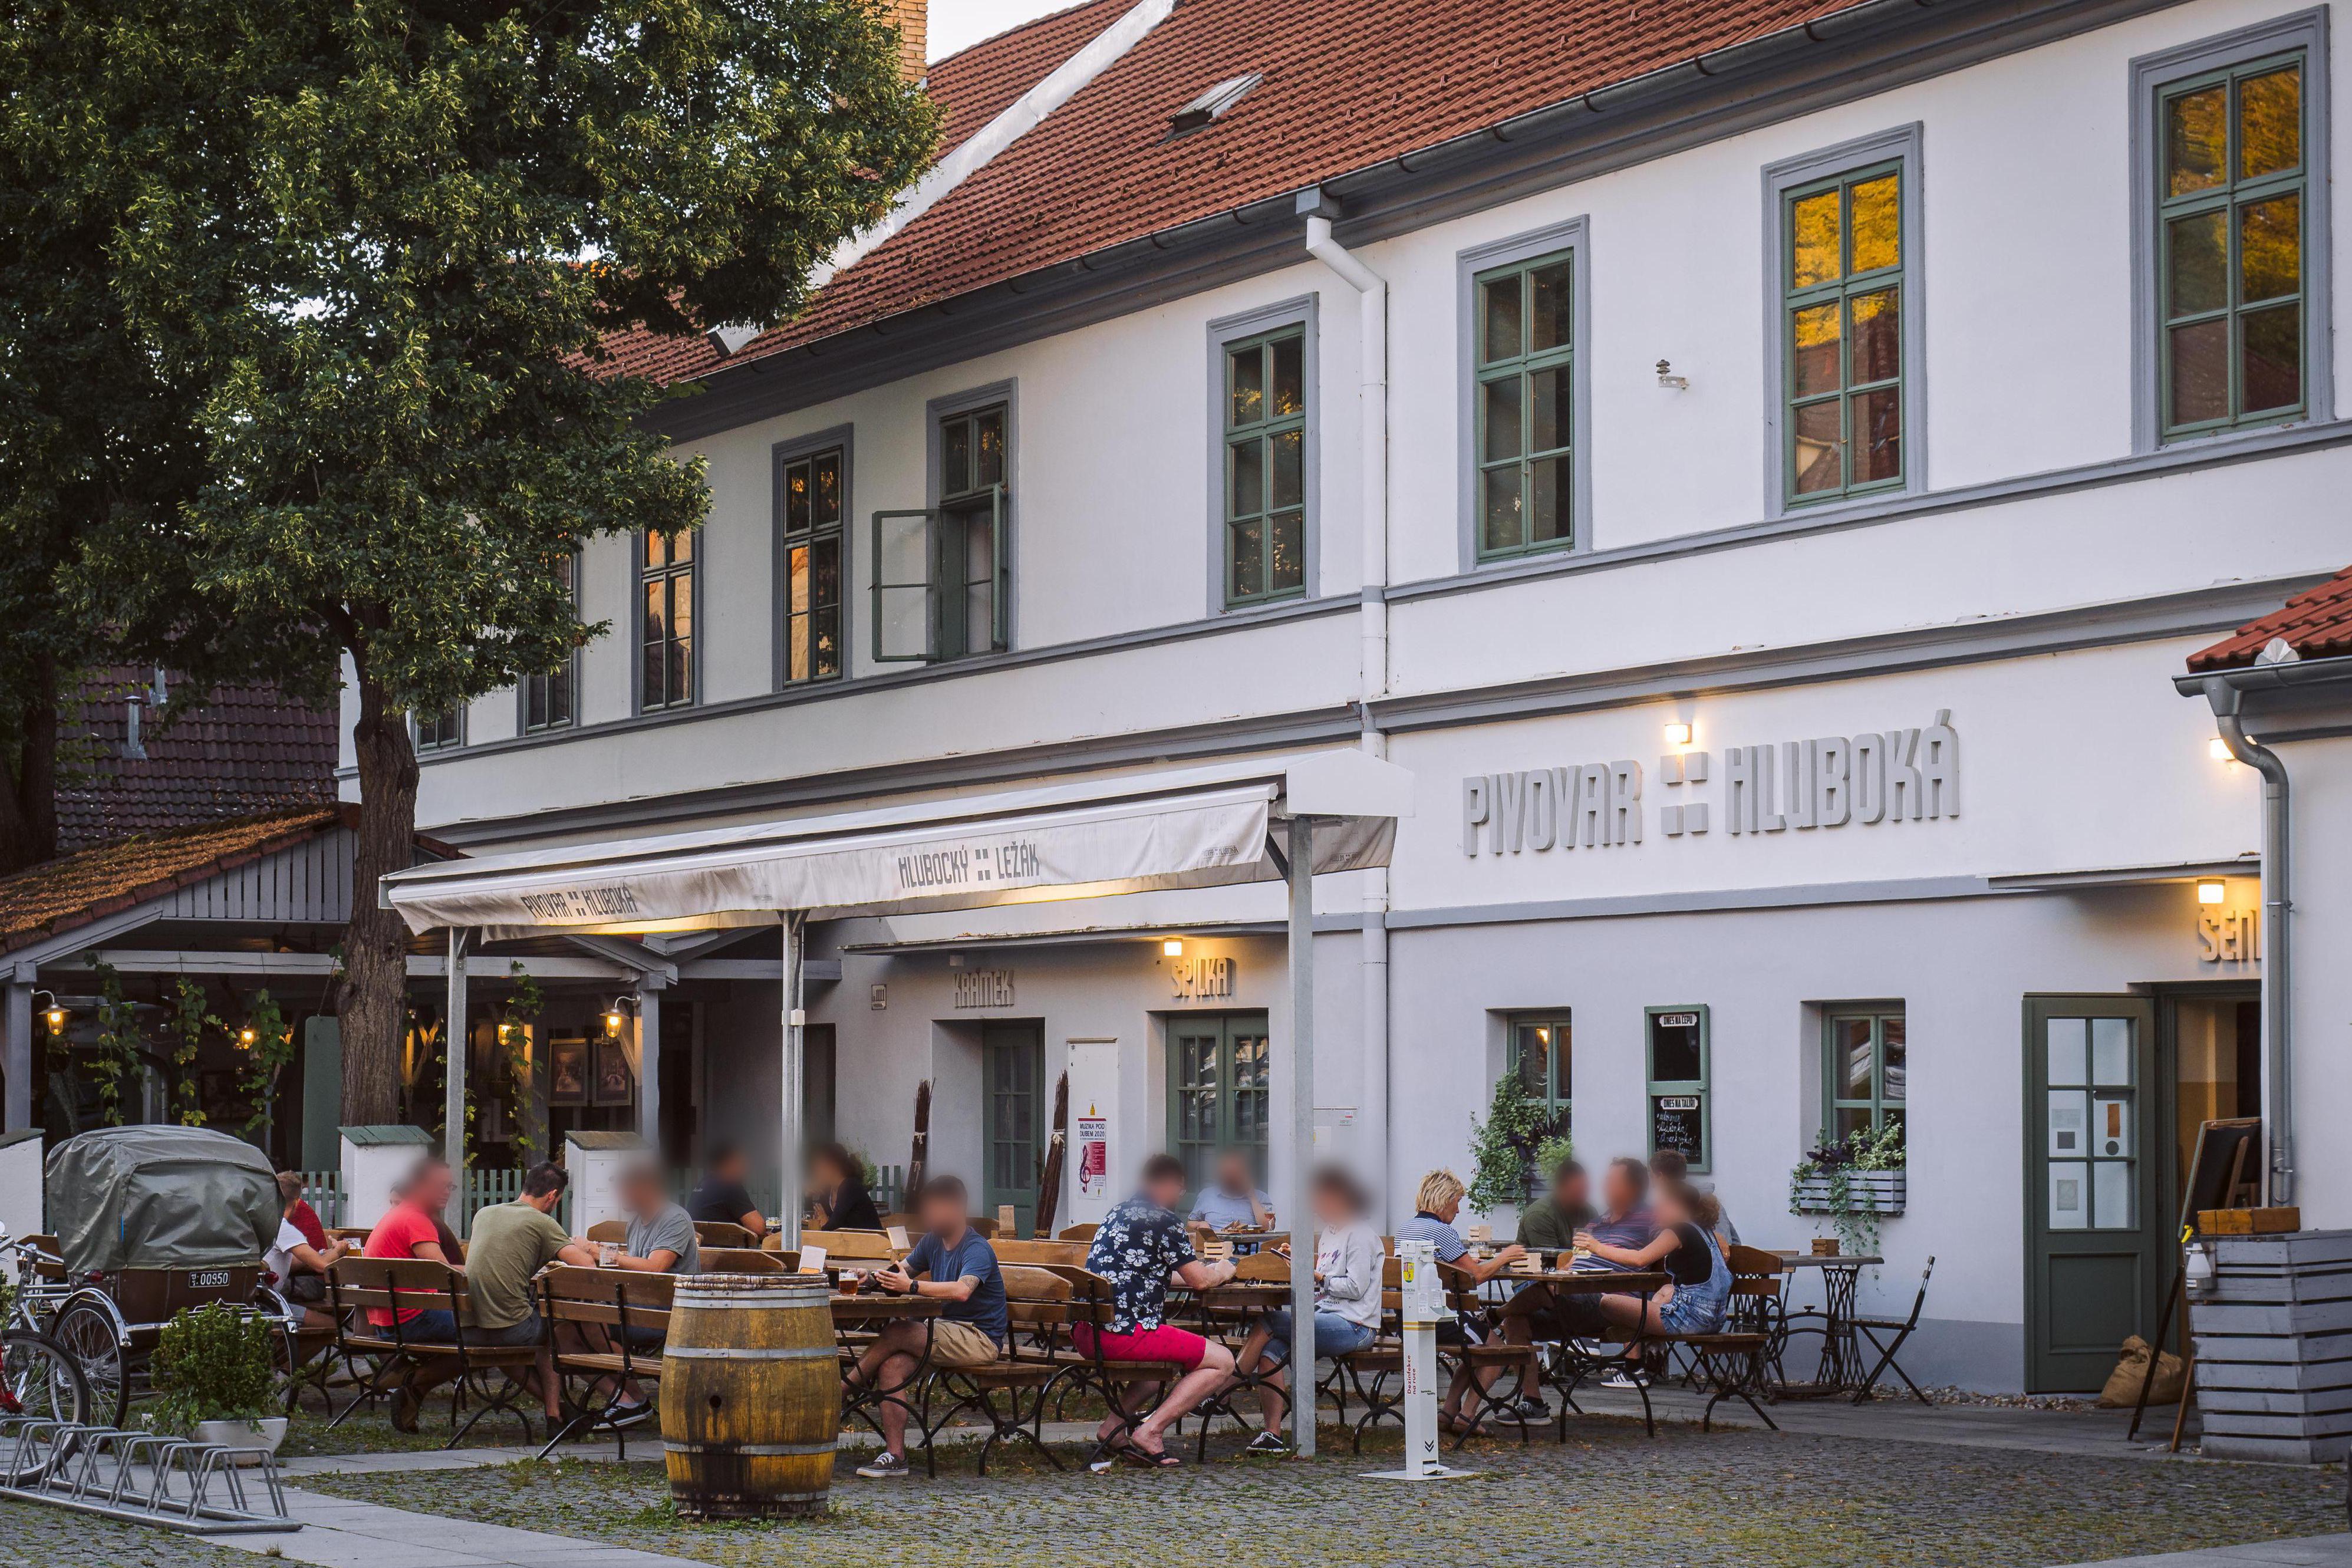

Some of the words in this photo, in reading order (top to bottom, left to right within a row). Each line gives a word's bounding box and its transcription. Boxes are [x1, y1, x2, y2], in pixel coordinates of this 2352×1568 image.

[1462, 759, 1642, 857] PIVOVAR
[1725, 709, 1959, 834] HLUBOKÁ
[898, 845, 969, 888] HLUBOCKÝ
[996, 839, 1040, 879] LEŽÁK
[521, 892, 573, 918] PIVOVAR
[581, 882, 638, 916] HLUBOKÁ
[1170, 957, 1232, 997] SPILKA
[1663, 1016, 1675, 1025] DNES
[1675, 1016, 1681, 1024] NA
[1682, 1014, 1693, 1025] ČEPU
[1663, 1099, 1675, 1108] DNES
[1675, 1099, 1681, 1108] NA
[1682, 1096, 1695, 1108] TALÍŘI
[200, 1273, 228, 1284] 00950
[1413, 1385, 1416, 1395] na
